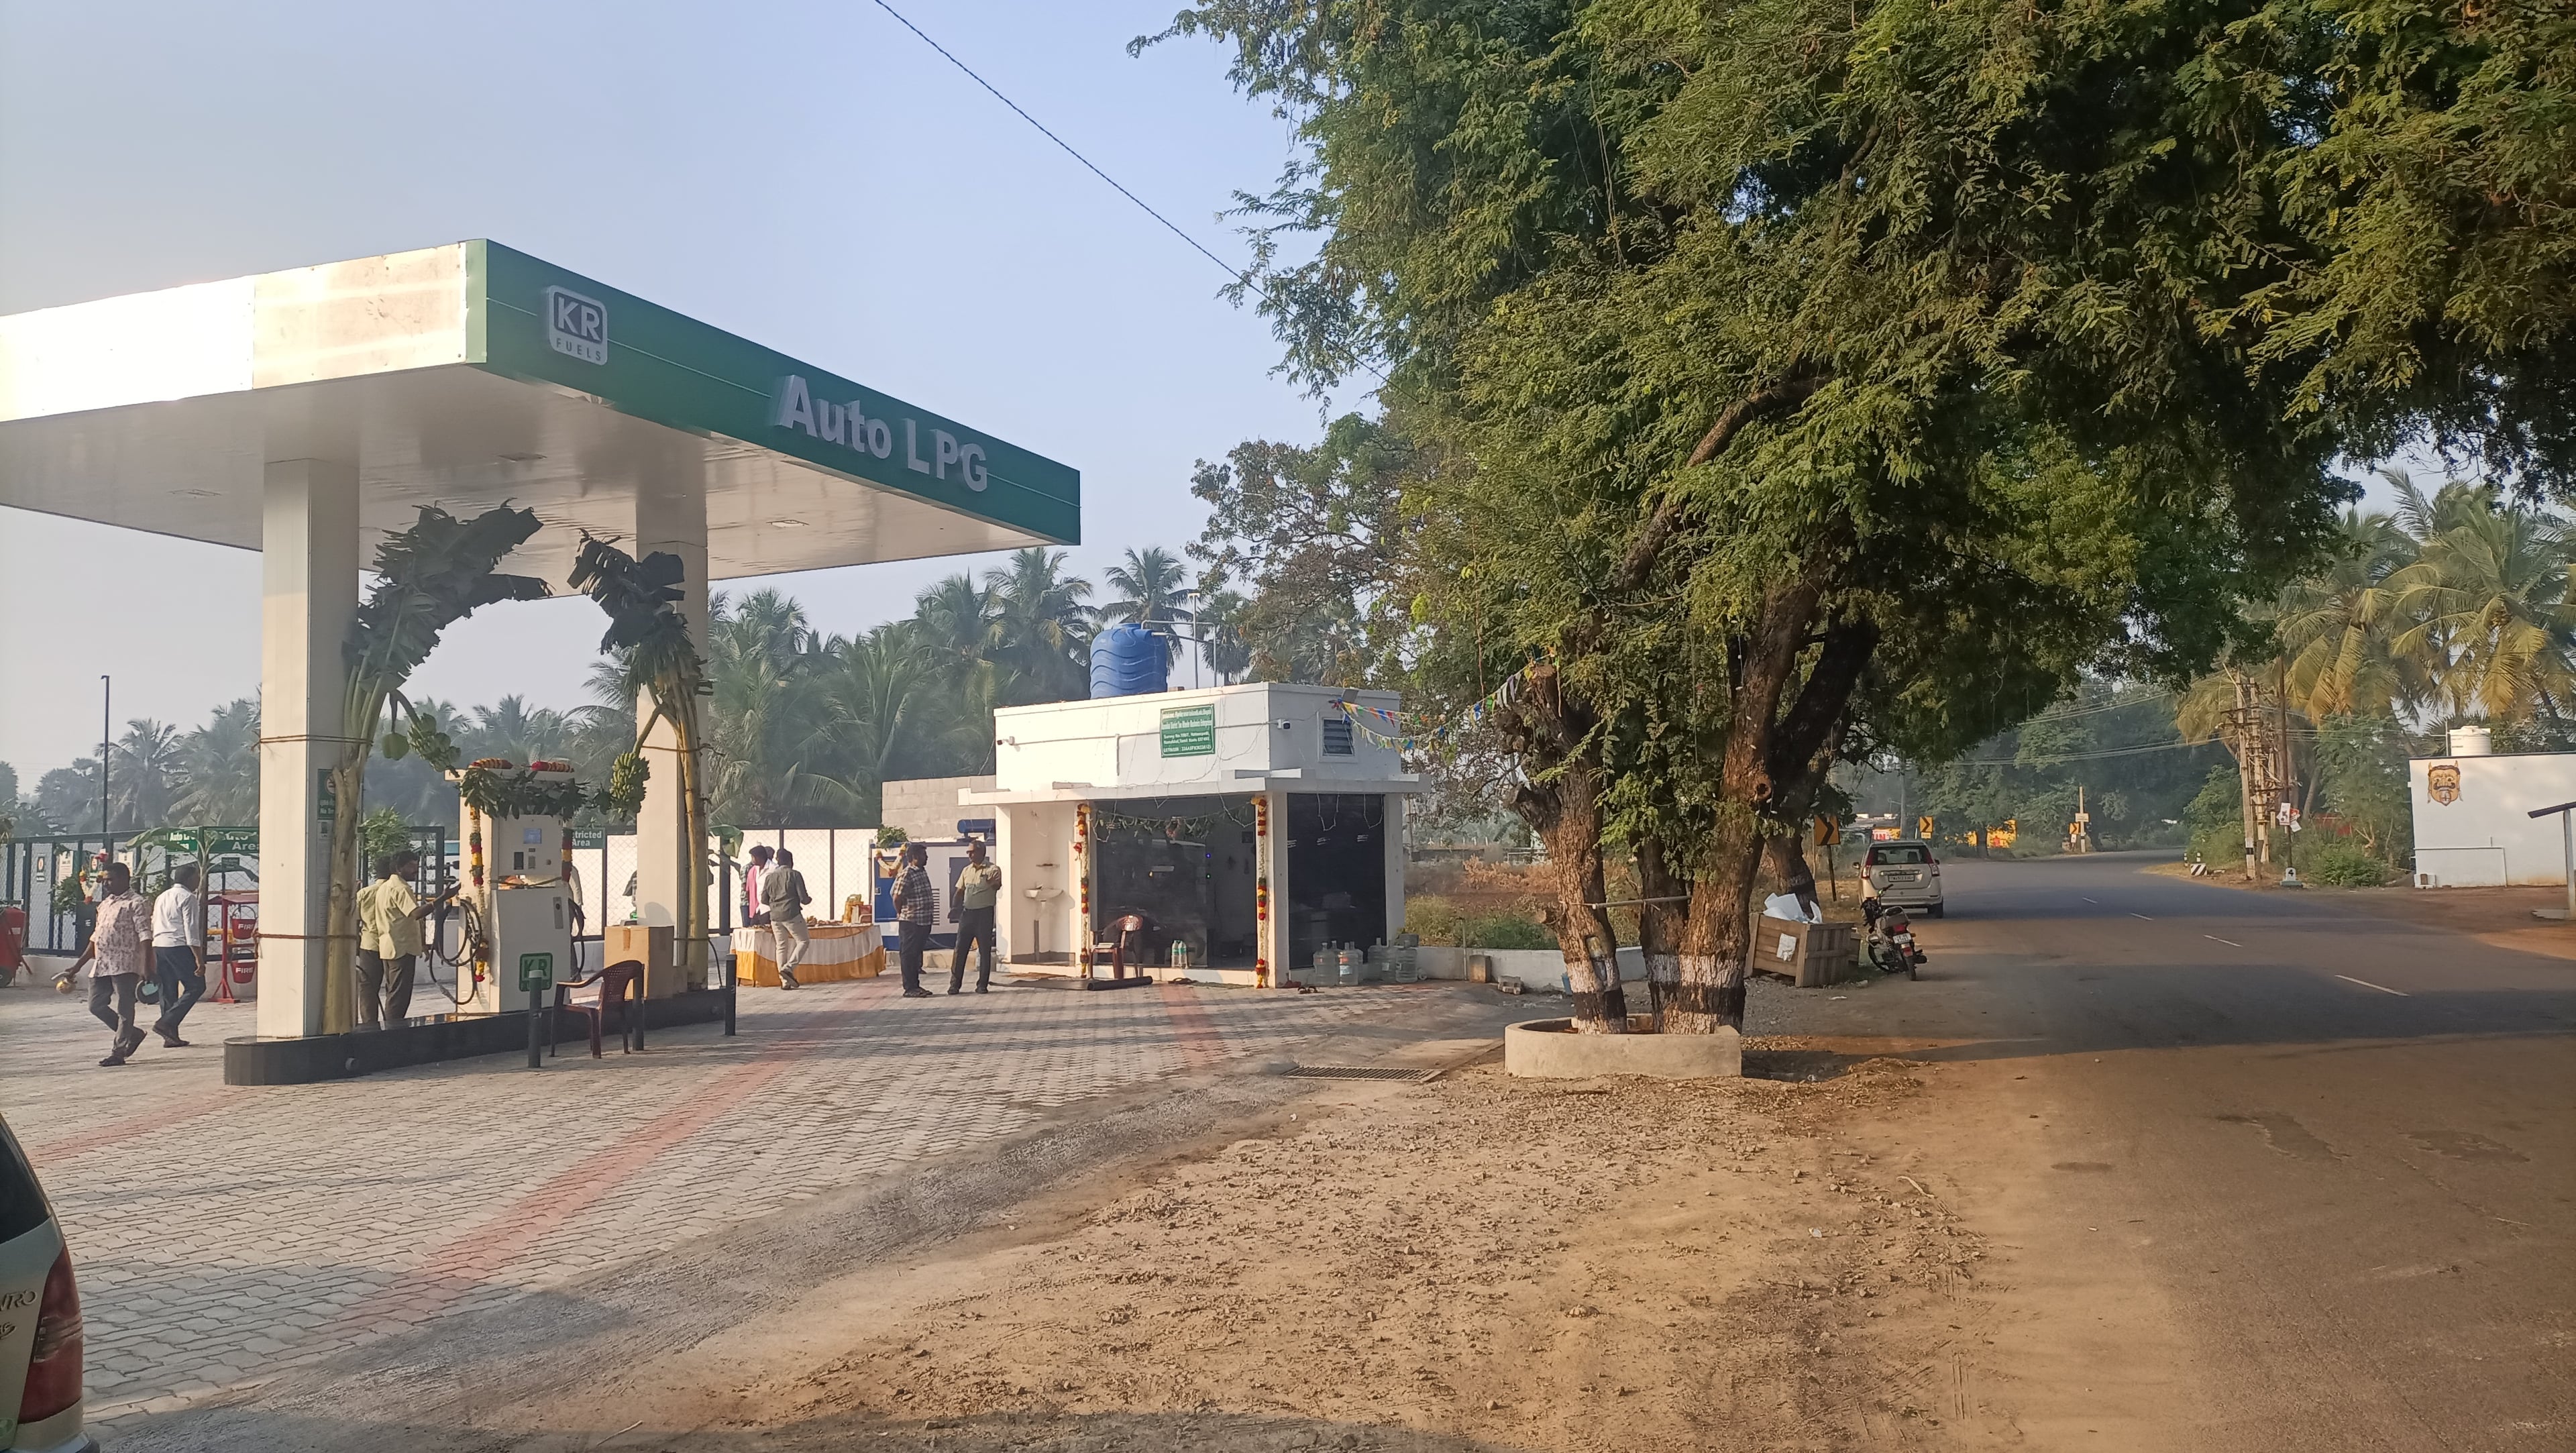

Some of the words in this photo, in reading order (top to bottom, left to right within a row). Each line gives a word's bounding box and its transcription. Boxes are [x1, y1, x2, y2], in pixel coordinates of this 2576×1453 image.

[558, 297, 602, 342] KR
[556, 337, 601, 361] FUELS
[773, 375, 892, 460] Auto
[902, 417, 987, 492] LPG
[572, 830, 602, 839] tricted
[572, 838, 590, 847] Area
[2288, 869, 2294, 877] 4
